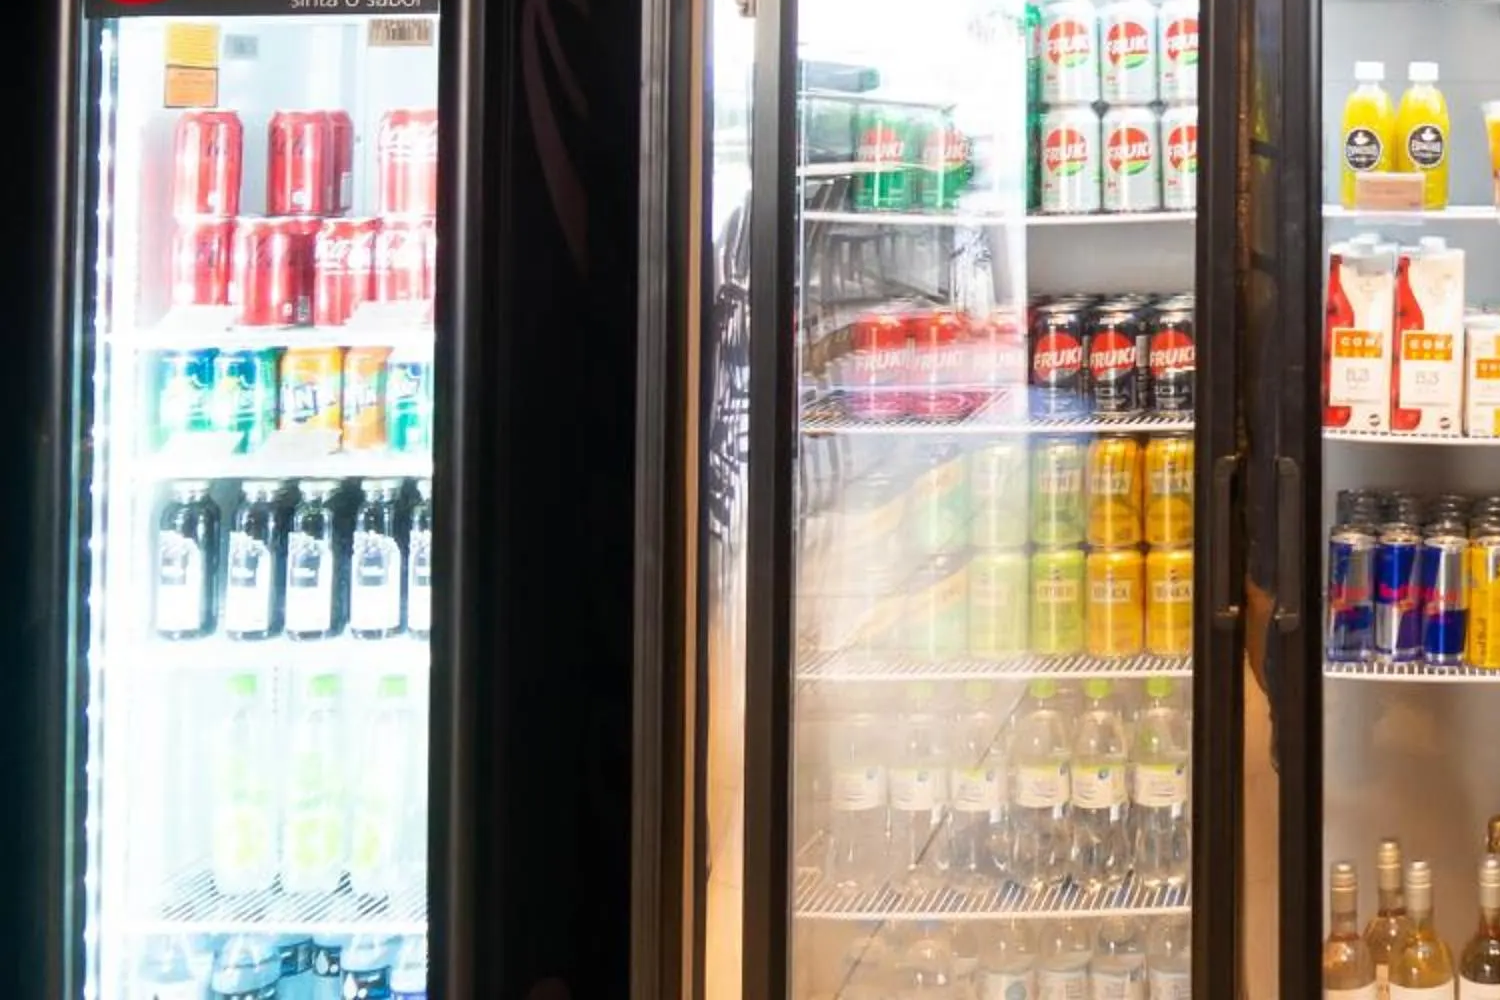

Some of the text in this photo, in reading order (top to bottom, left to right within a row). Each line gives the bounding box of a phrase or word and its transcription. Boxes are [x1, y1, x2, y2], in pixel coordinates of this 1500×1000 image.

[1034, 346, 1082, 370] FRUKI
[1090, 346, 1136, 369] FRUKI
[1150, 345, 1196, 368] FRUKI
